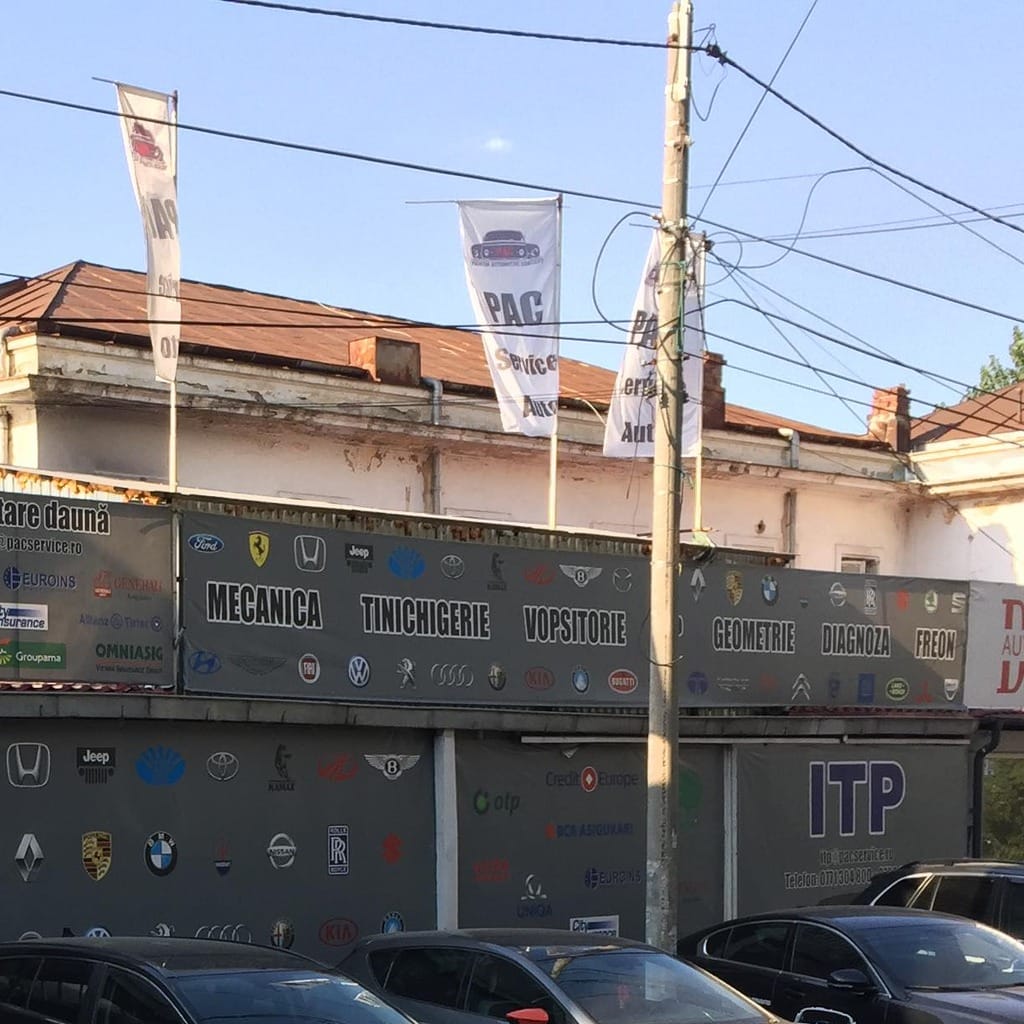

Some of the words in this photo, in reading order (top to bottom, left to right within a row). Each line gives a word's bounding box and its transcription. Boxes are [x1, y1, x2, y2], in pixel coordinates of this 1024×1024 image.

[483, 291, 543, 327] PAC
[631, 310, 658, 350] PA
[495, 348, 558, 375] Service
[621, 422, 655, 442] Aut
[43, 503, 111, 535] daună
[349, 546, 370, 559] Jeep
[23, 573, 77, 589] EUROINS
[207, 581, 323, 630] MECANICA
[360, 594, 491, 640] TINICHIGERIE
[524, 605, 627, 647] VOPSITORIE
[712, 616, 796, 654] GEOMETRIE
[821, 623, 891, 658] DIAGNOZA
[914, 628, 958, 661] FREON
[16, 651, 61, 664] Groupama
[96, 643, 163, 660] OMNIASIG
[83, 749, 110, 764] Jeep
[599, 772, 639, 788] Europe
[809, 761, 906, 838] ITP
